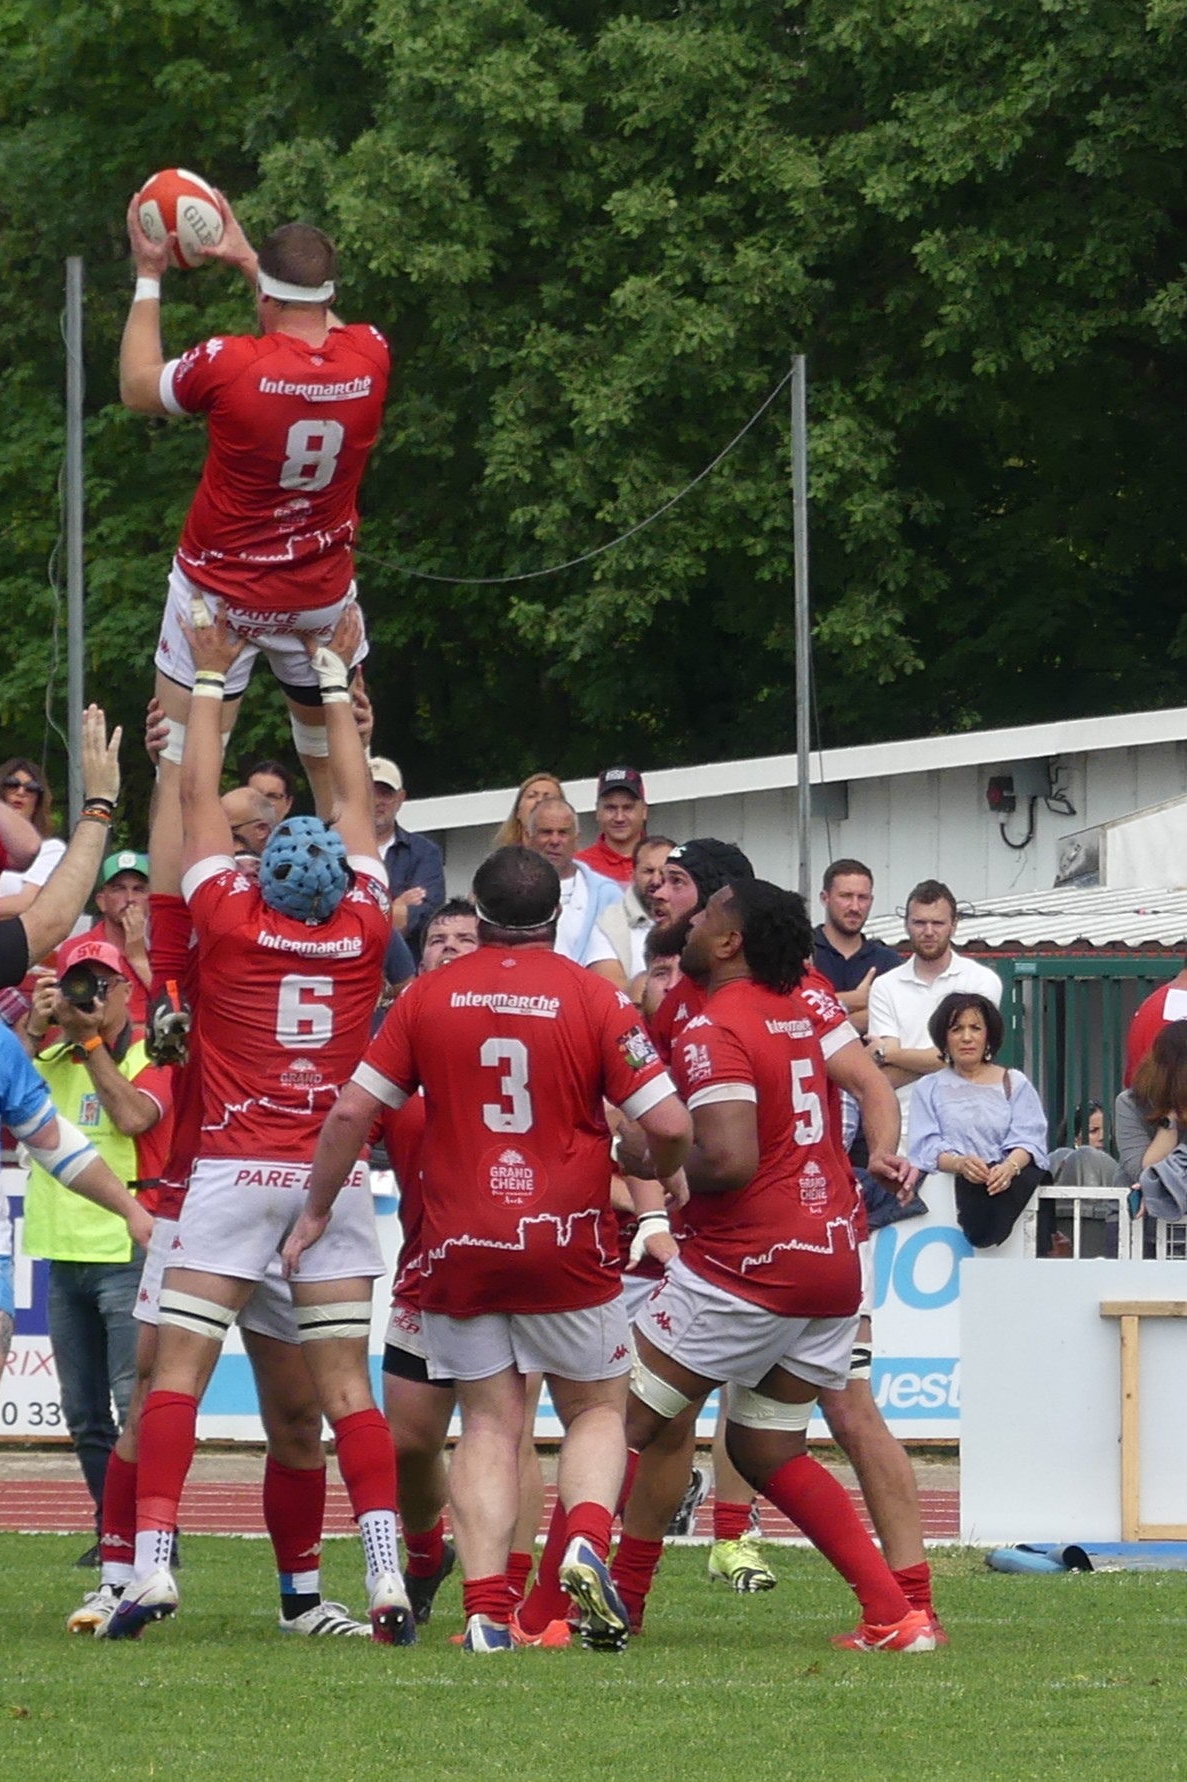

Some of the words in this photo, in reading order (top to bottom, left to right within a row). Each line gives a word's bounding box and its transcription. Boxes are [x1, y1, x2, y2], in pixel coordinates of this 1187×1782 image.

[259, 375, 372, 399] Intermarché
[278, 419, 345, 492] 8
[77, 943, 102, 958] SW
[256, 929, 363, 955] Intermarché
[275, 973, 334, 1049] 6
[450, 991, 561, 1014] Intermarché
[479, 1037, 533, 1134] 3
[790, 1058, 824, 1146] 5
[489, 1166, 533, 1179] GRAND
[27, 1401, 61, 1427] 33
